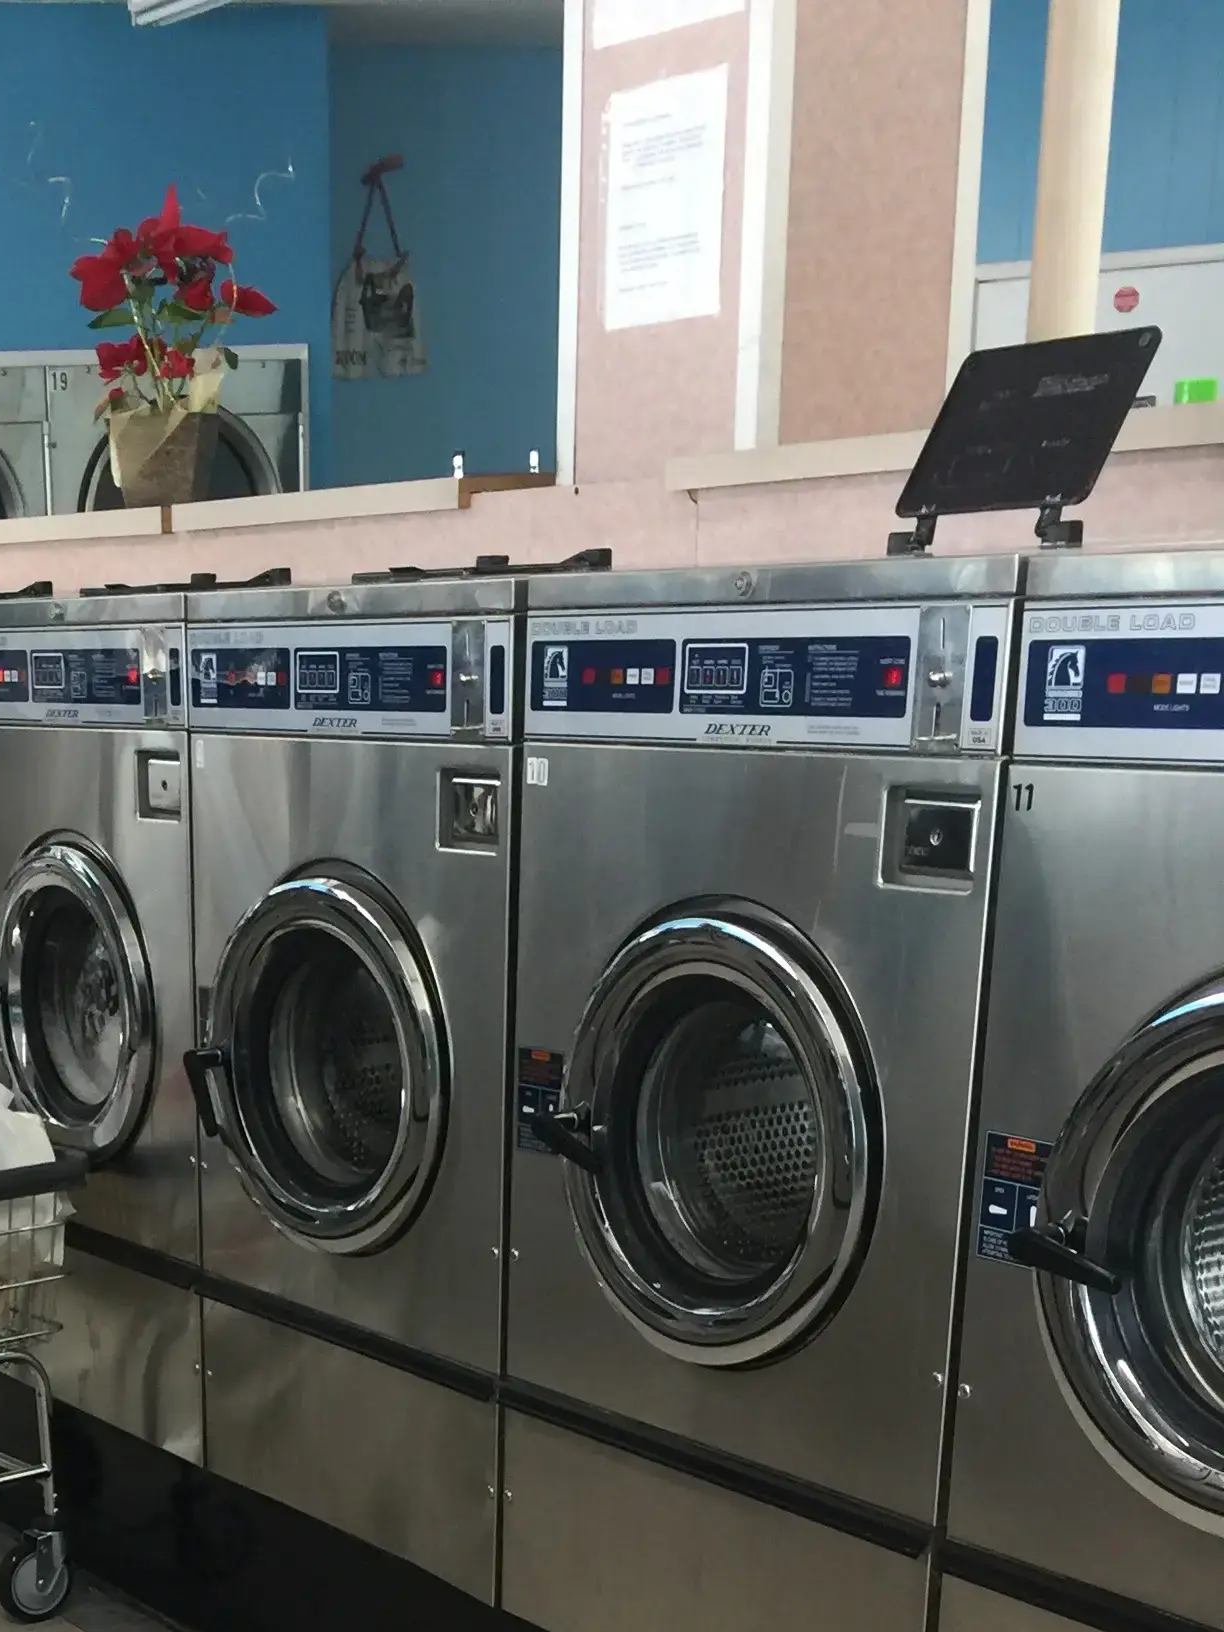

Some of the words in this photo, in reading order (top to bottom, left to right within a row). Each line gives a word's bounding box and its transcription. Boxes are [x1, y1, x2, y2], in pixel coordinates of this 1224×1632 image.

[52, 372, 67, 391] 19
[595, 620, 638, 634] LOAD
[1029, 615, 1121, 634] DOUBLE
[1129, 613, 1196, 631] LOAD
[1044, 698, 1082, 712] 300
[312, 718, 357, 728] DEXTER
[704, 723, 771, 736] DEXTER
[1013, 783, 1034, 811] 11
